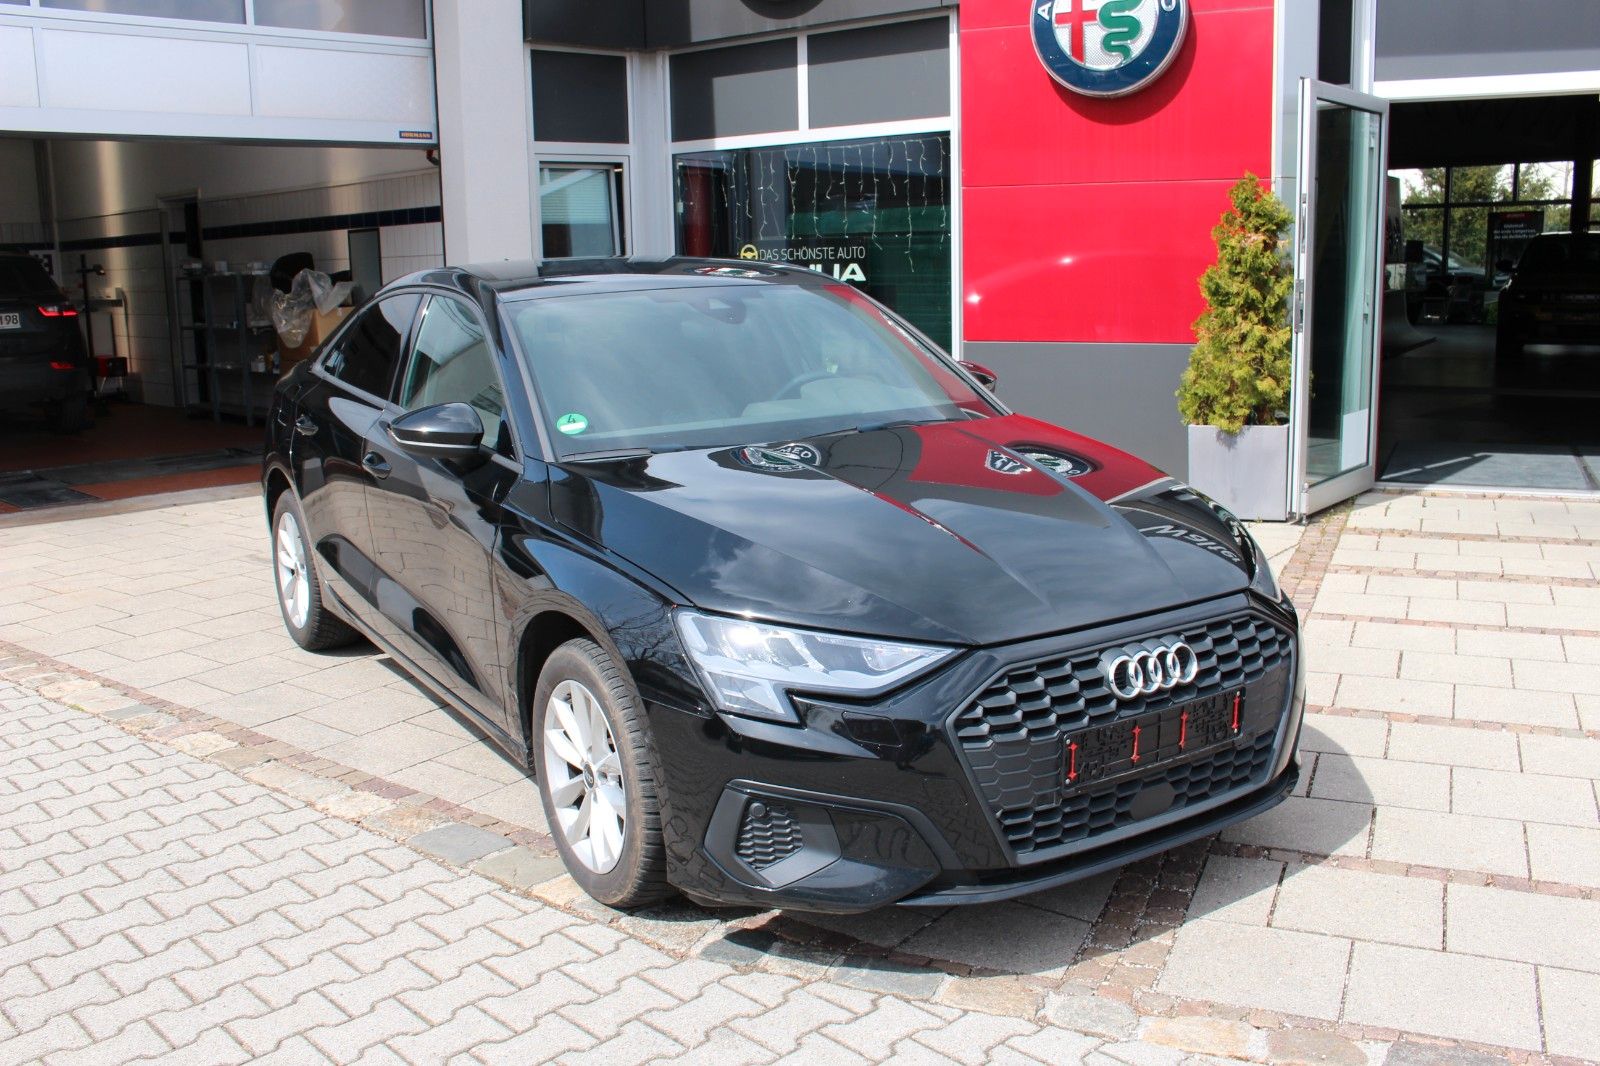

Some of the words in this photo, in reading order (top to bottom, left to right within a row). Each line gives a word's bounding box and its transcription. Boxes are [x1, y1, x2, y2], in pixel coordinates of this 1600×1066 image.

[760, 249, 779, 260] DAS
[780, 246, 835, 260] SCHÖNSTE
[837, 246, 866, 259] AUTO
